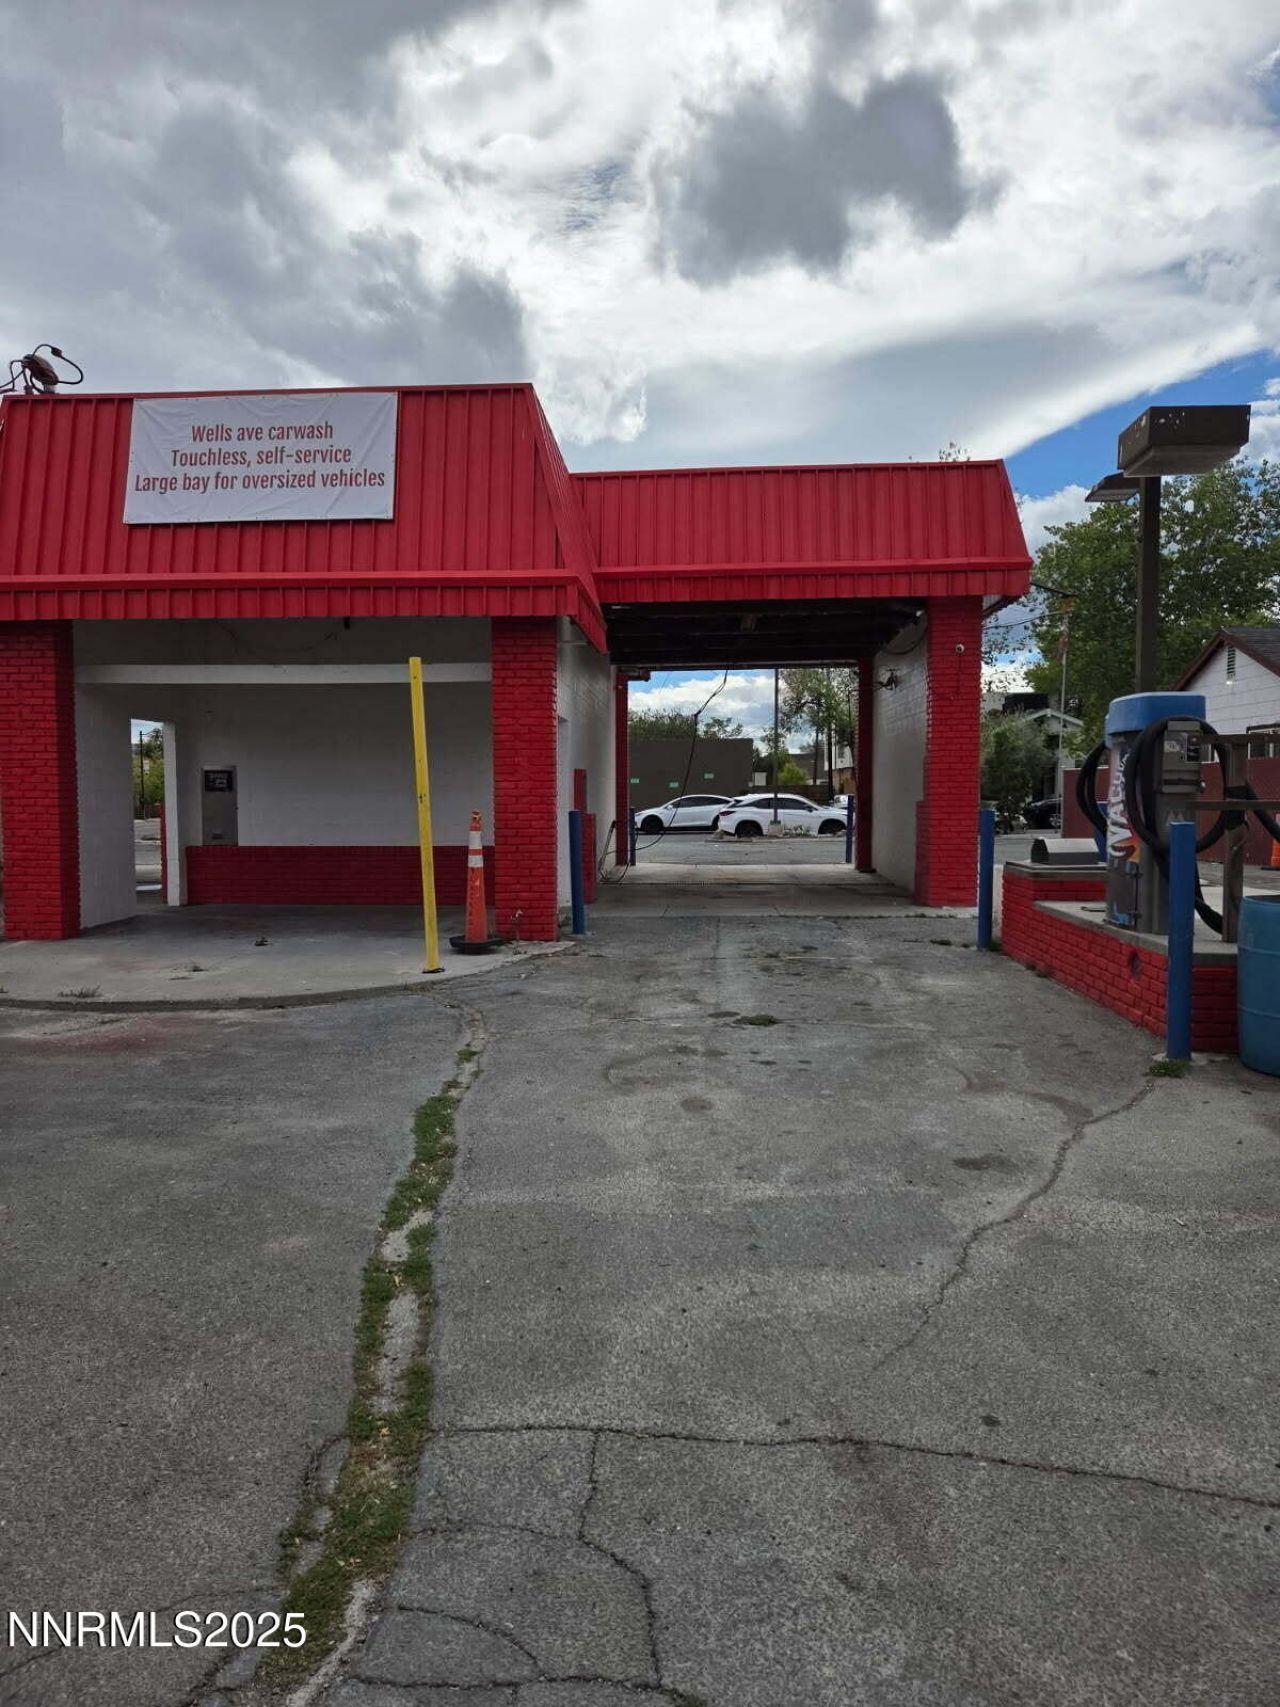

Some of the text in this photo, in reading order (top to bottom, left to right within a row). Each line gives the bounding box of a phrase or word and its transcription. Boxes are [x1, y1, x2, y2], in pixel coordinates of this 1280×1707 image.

[191, 421, 333, 443] Wells ave carwash
[171, 445, 351, 468] Touchless, self-service
[135, 468, 385, 494] Large bay for oversized vehicles
